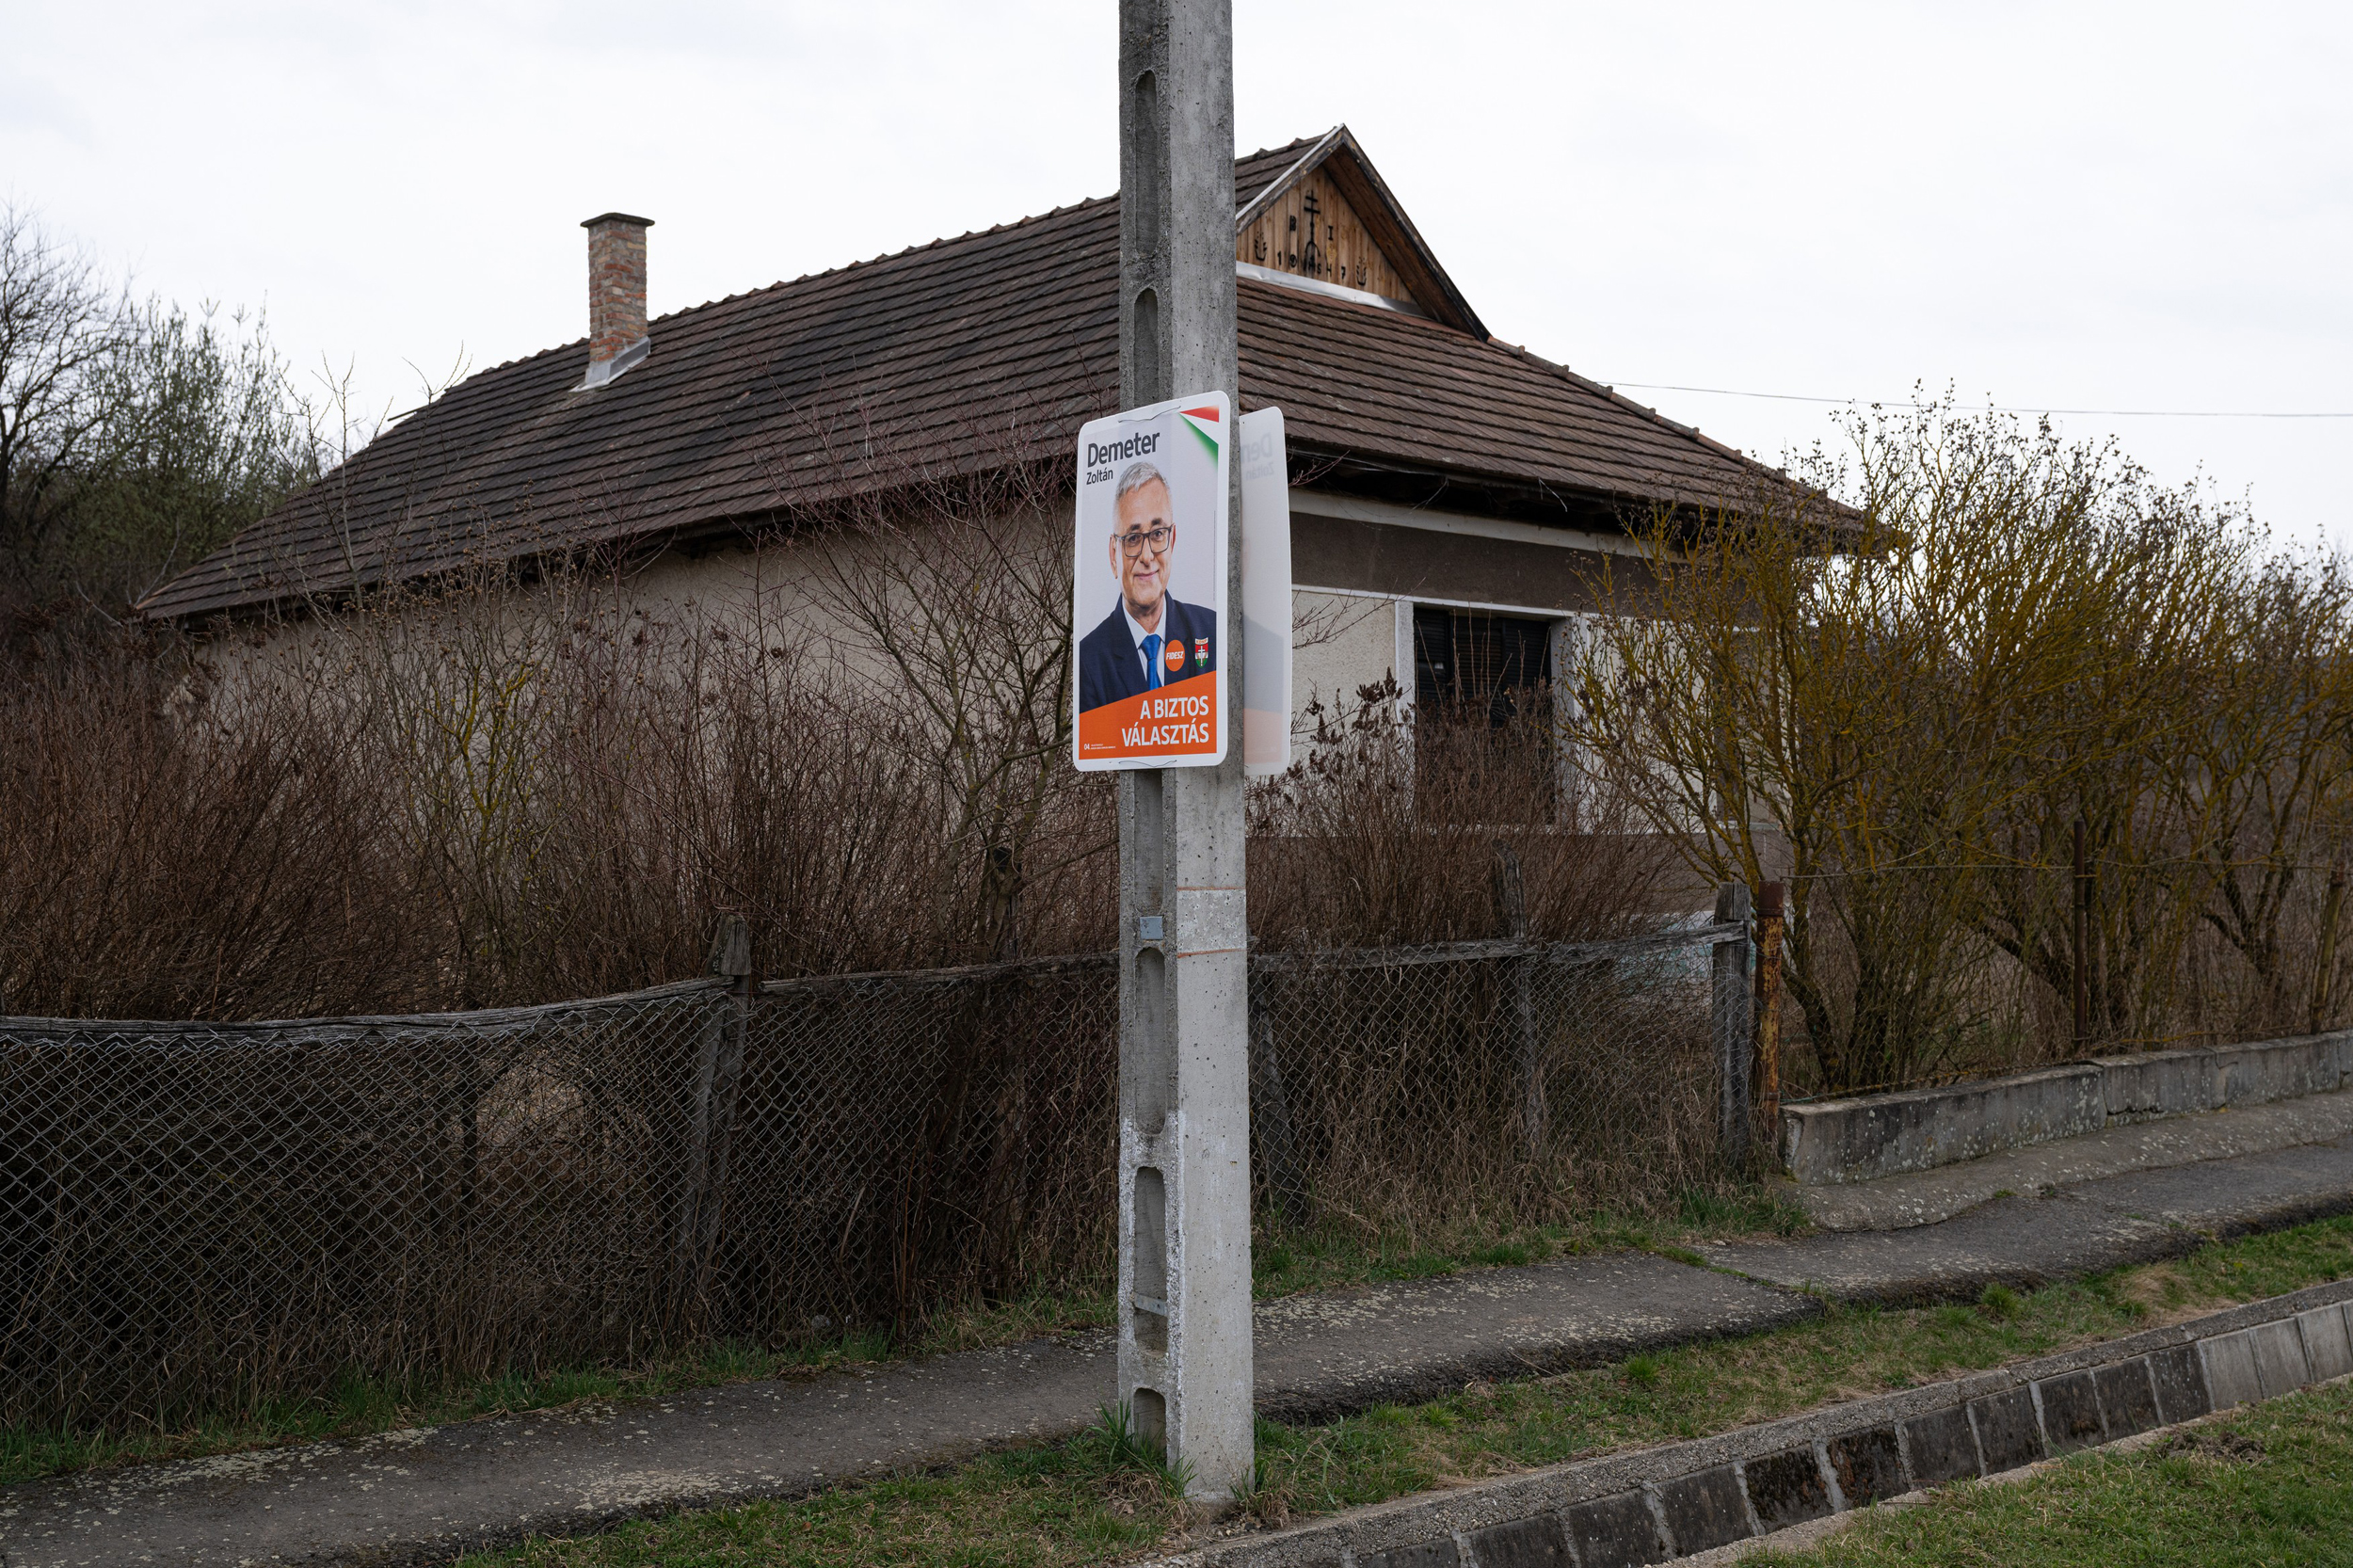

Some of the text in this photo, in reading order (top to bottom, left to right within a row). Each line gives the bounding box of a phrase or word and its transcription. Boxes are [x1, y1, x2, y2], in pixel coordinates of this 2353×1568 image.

[1328, 226, 1333, 241] I
[1087, 432, 1160, 468] Demeter
[1086, 467, 1113, 485] Zoltán
[1166, 650, 1184, 660] FIDESZ
[1140, 696, 1209, 720] A BIZTOS
[1121, 718, 1209, 747] VÁLASZTÁS
